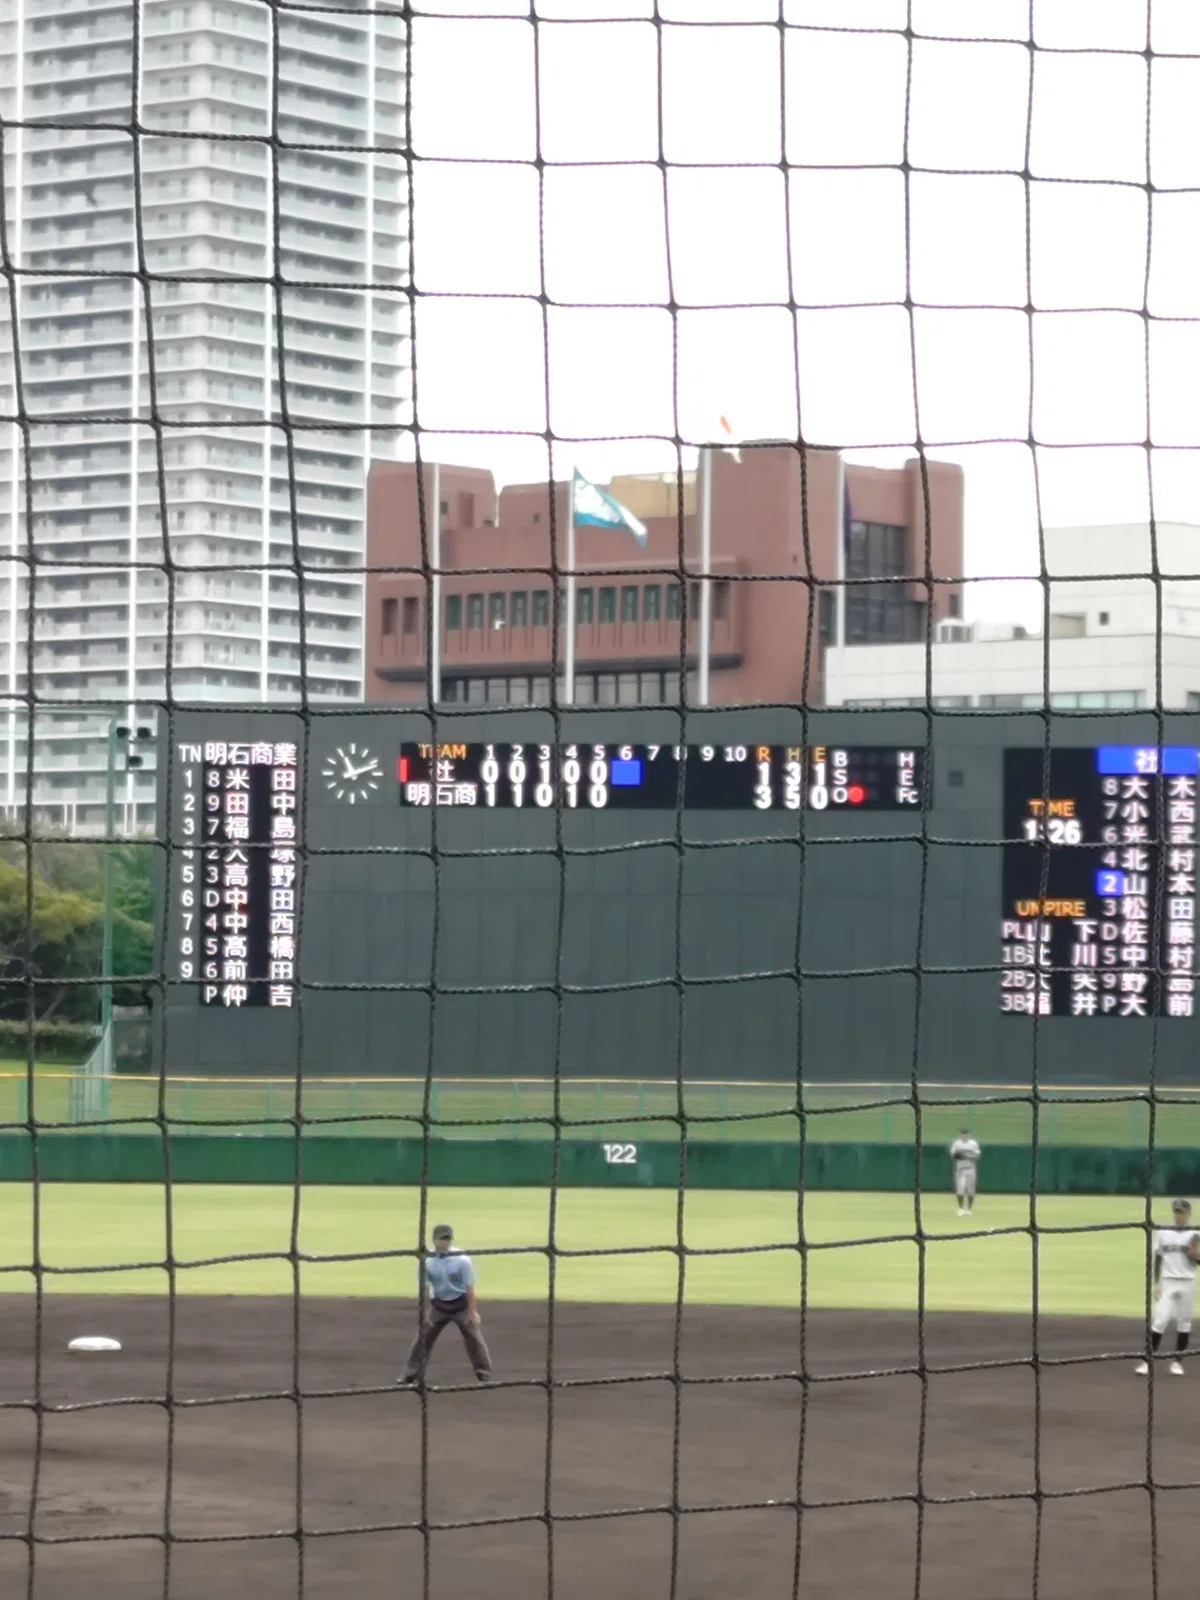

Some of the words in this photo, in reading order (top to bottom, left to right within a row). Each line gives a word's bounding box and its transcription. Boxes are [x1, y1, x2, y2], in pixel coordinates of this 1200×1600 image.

[179, 744, 201, 762] TN
[205, 742, 297, 765] 明石商業
[487, 744, 496, 760] 1
[512, 744, 524, 760] 2
[539, 745, 550, 760] 3
[565, 745, 577, 759] 4
[594, 745, 605, 760] 5
[620, 746, 632, 760] 6
[648, 746, 660, 760] 7
[702, 746, 714, 761] 9
[725, 747, 747, 761] 10
[758, 747, 771, 761] R
[815, 748, 826, 762] E
[833, 751, 848, 767] B
[898, 752, 914, 768] H
[184, 769, 193, 788] 1
[208, 771, 219, 787] 8
[482, 760, 499, 783] 0
[509, 760, 526, 783] 0
[540, 760, 550, 784] 1
[564, 760, 580, 784] 0
[590, 761, 607, 785] 0
[758, 762, 769, 786] 1
[785, 762, 801, 786] 3
[814, 763, 825, 786] 1
[833, 769, 848, 785] S
[900, 770, 914, 786] E
[833, 787, 848, 803] O
[1103, 777, 1119, 796] 8
[184, 794, 195, 811] 2
[208, 794, 219, 811] 9
[485, 784, 496, 807] 1
[513, 784, 523, 807] 1
[536, 784, 553, 807] 0
[566, 784, 577, 807] 1
[590, 785, 607, 808] 0
[755, 785, 772, 809] 3
[785, 786, 801, 809] 5
[811, 786, 828, 810] 0
[1104, 802, 1118, 819] 7
[183, 818, 194, 834] 3
[208, 819, 219, 835] 7
[1103, 827, 1117, 844] 6
[1103, 850, 1117, 868] 4
[182, 865, 194, 883] 5
[207, 866, 218, 883] 3
[1103, 876, 1117, 895] 2
[182, 890, 193, 907] 6
[206, 890, 219, 907] D
[1103, 900, 1116, 917] 3
[182, 914, 193, 931] 7
[206, 914, 217, 931] 4
[1102, 923, 1118, 939] D
[181, 938, 193, 954] 8
[206, 938, 218, 955] 5
[1103, 947, 1116, 964] 5
[181, 962, 193, 978] 9
[206, 962, 217, 978] 6
[1103, 972, 1116, 989] 9
[206, 986, 217, 1003] P
[1103, 996, 1117, 1013] P
[603, 1144, 637, 1163] 122
